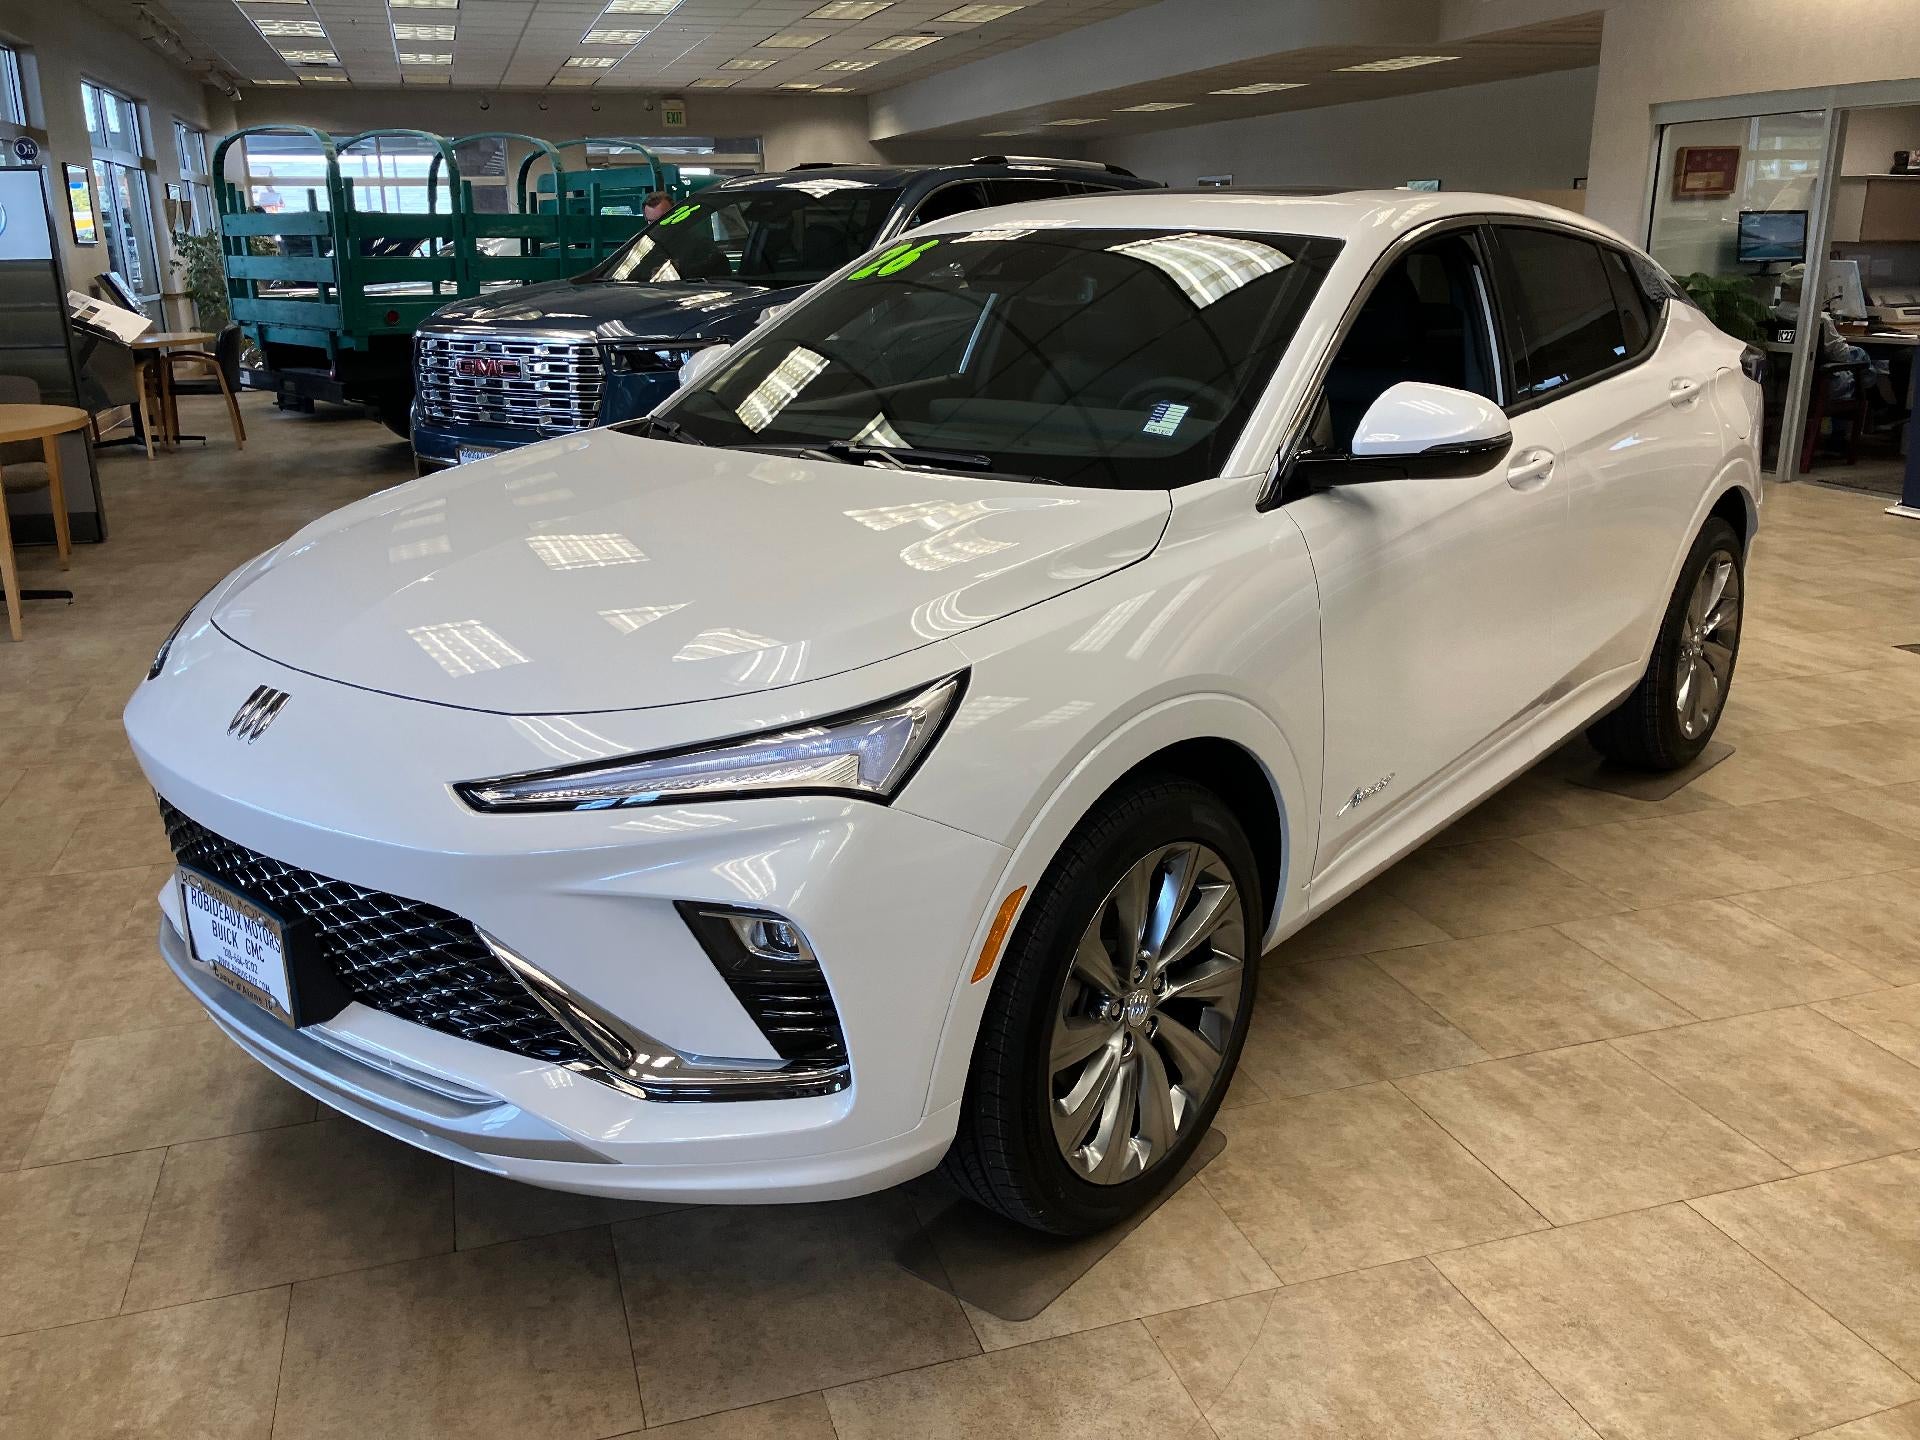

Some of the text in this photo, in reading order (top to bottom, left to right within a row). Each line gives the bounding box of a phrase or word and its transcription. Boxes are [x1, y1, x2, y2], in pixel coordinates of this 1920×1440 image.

[666, 111, 682, 125] EXIT
[847, 239, 940, 280] 26
[457, 357, 521, 377] GMC
[191, 888, 243, 931] ROBIDEAUX
[243, 917, 281, 954] MOTORS
[212, 920, 265, 963] BUICK GMC
